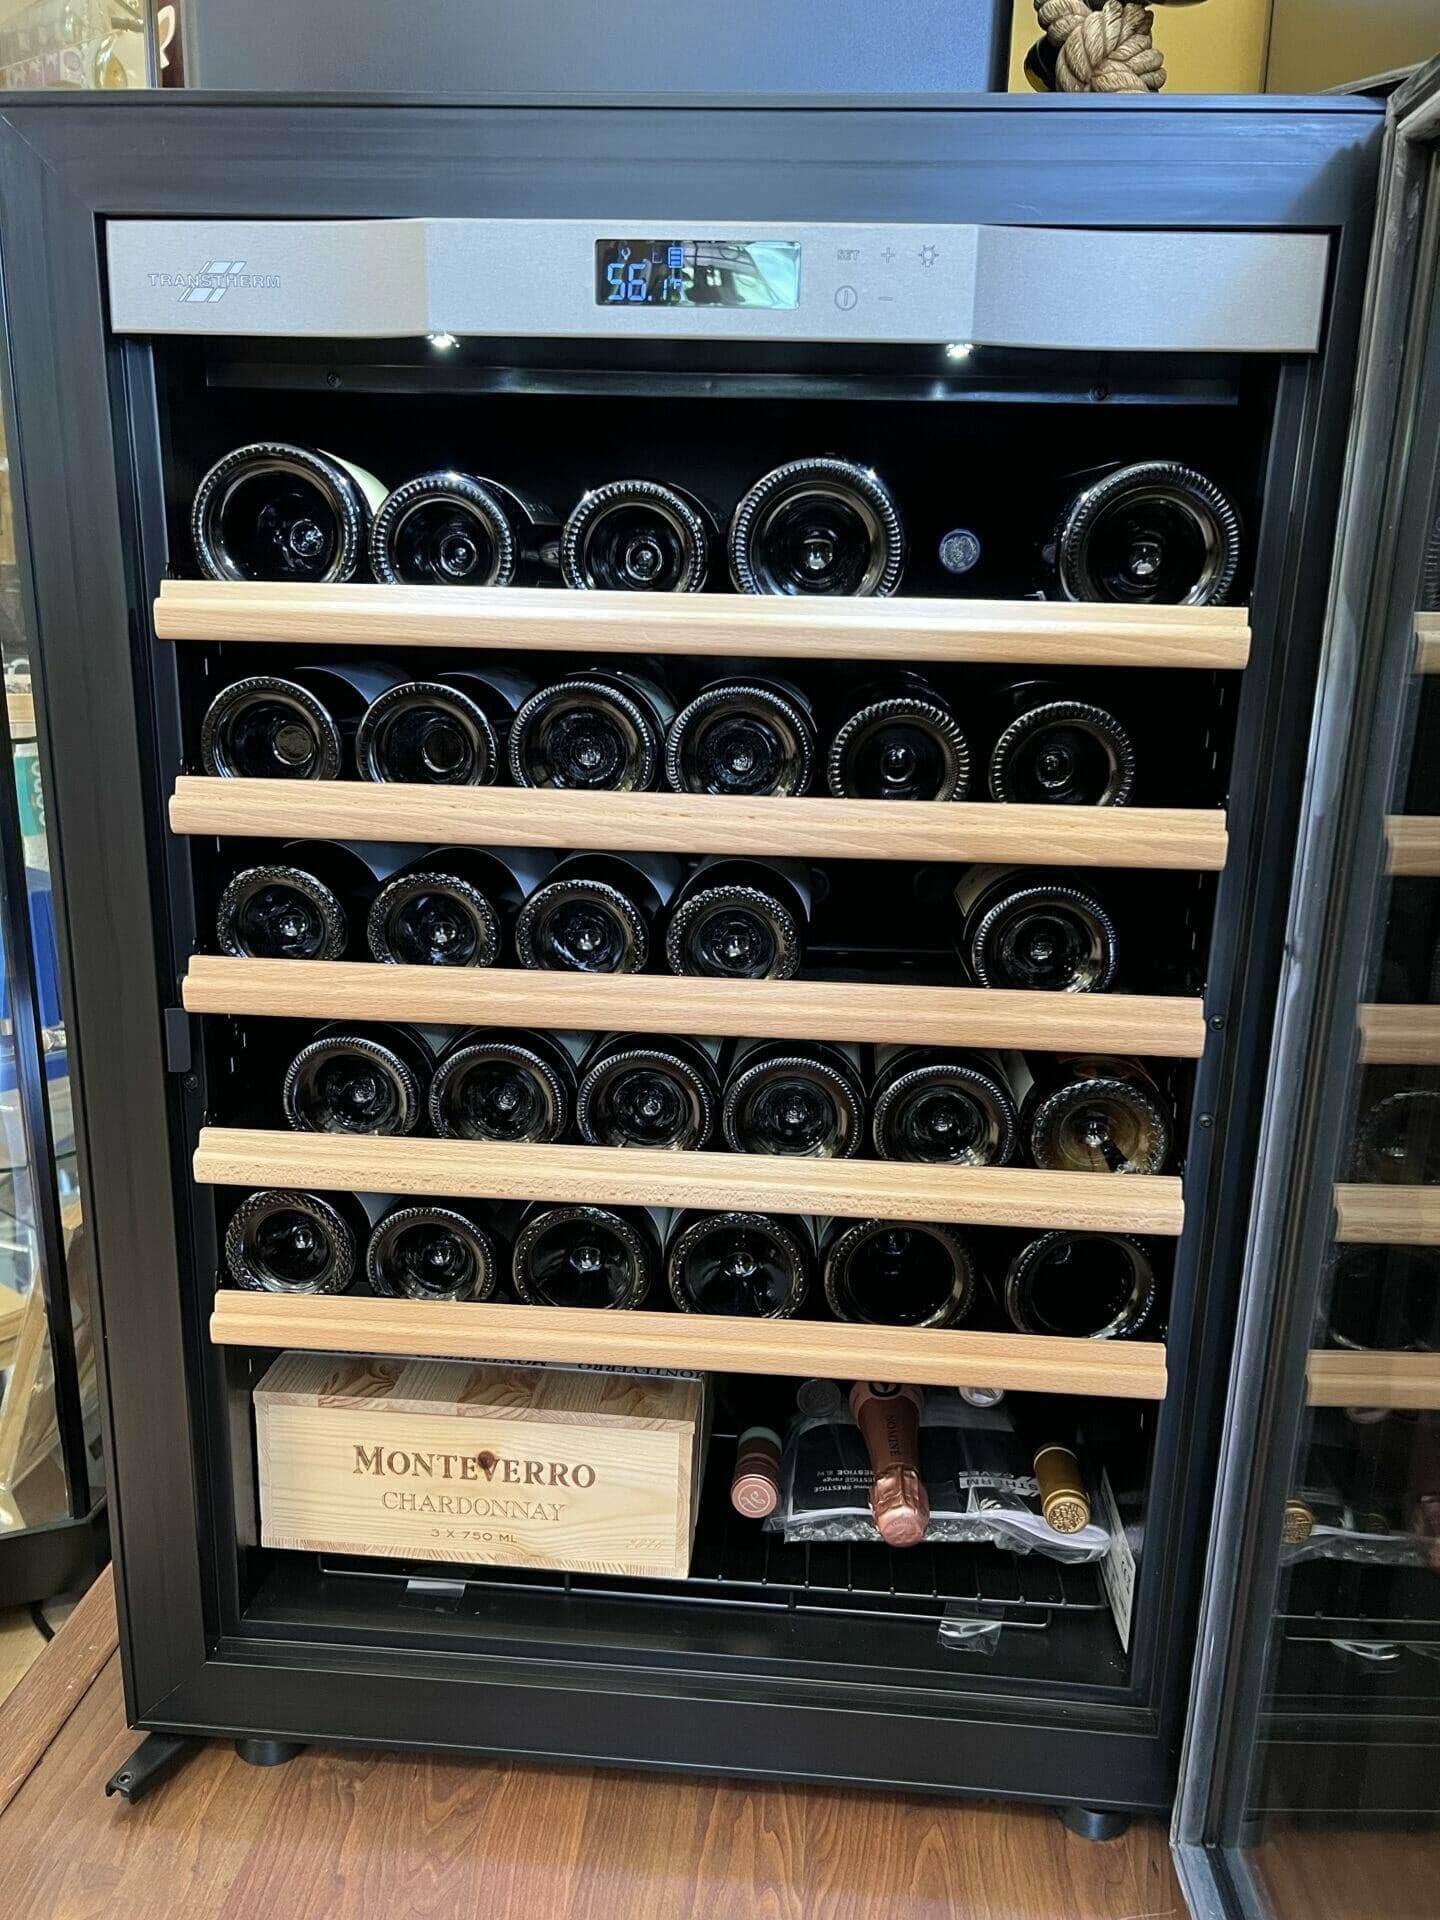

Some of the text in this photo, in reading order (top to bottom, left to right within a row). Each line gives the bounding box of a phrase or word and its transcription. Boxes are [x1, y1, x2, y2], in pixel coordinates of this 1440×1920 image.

[837, 249, 860, 261] SET
[147, 272, 281, 289] TRANSTHERM
[353, 1444, 597, 1489] MONTEVERRO
[381, 1491, 566, 1522] CHARDONNAY
[430, 1528, 441, 1538] 3
[463, 1531, 493, 1542] 750
[499, 1534, 518, 1544] ML
